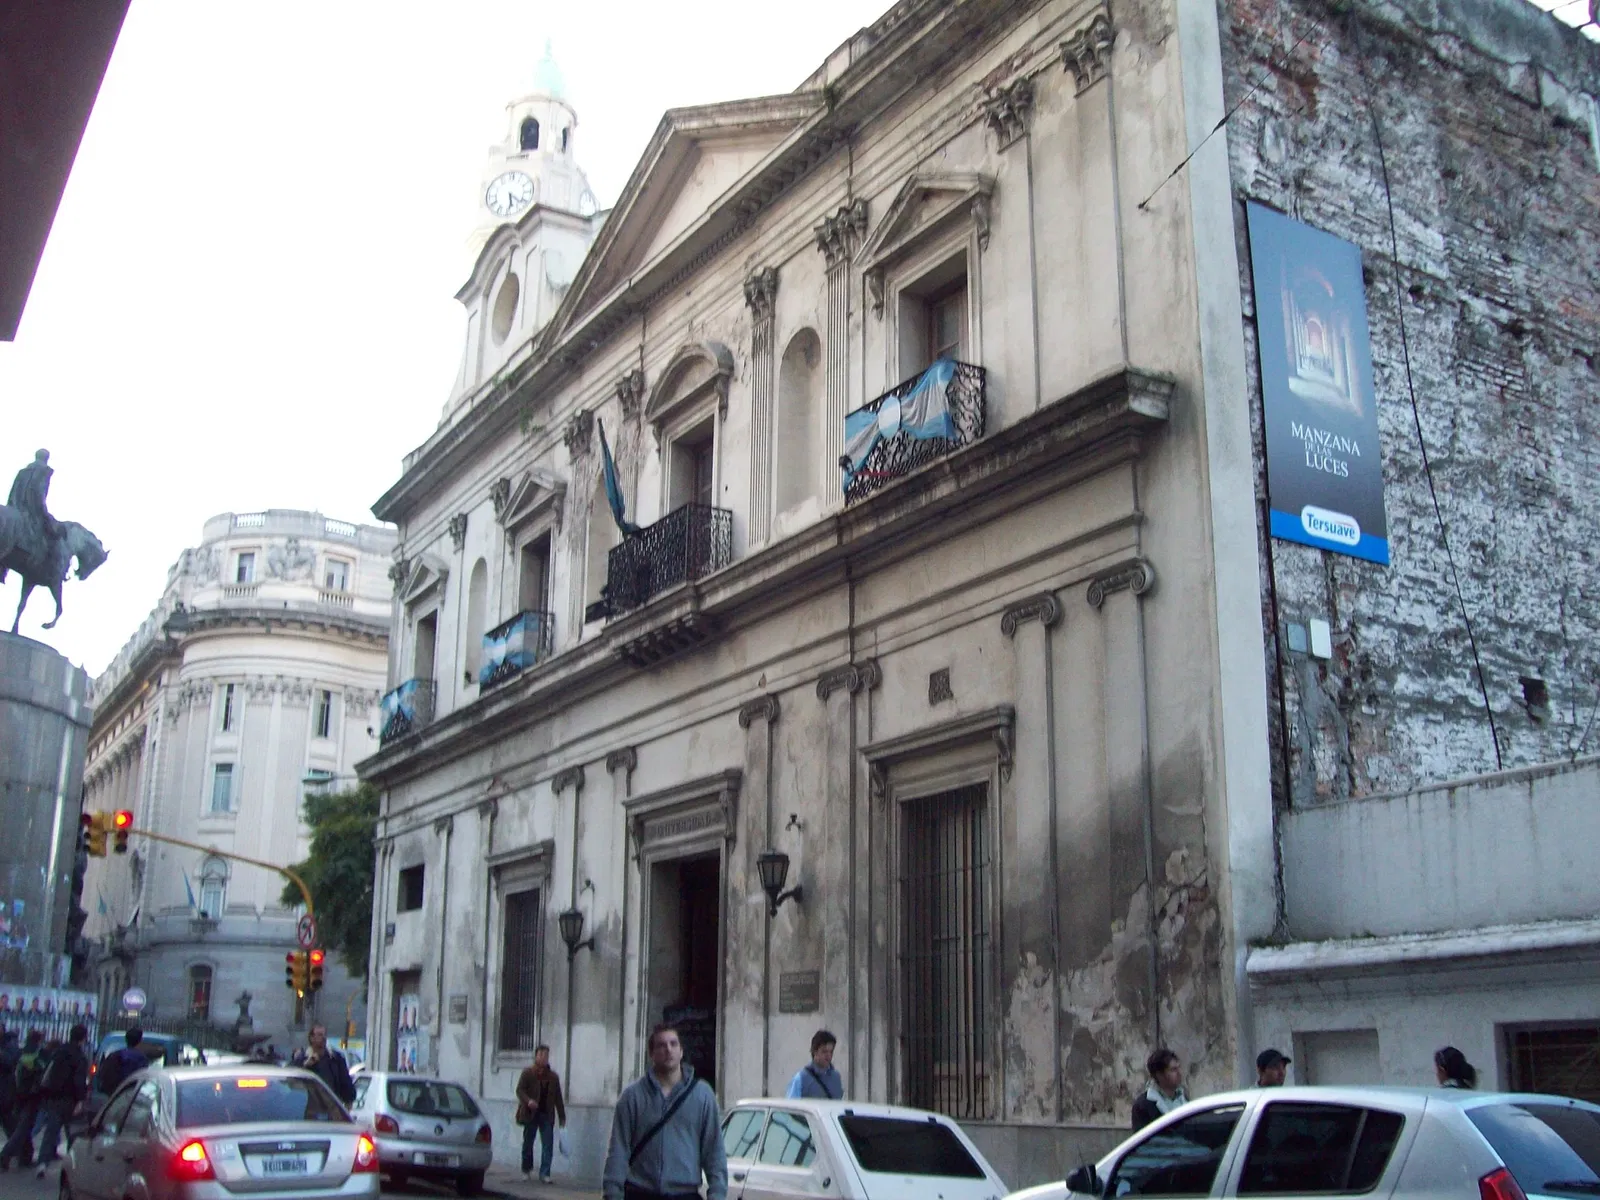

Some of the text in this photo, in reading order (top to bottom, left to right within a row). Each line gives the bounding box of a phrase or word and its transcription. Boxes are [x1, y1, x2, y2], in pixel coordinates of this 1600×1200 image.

[1291, 420, 1361, 457] MANZANA
[1305, 450, 1349, 478] LUCES
[1306, 512, 1356, 539] Tersuave
